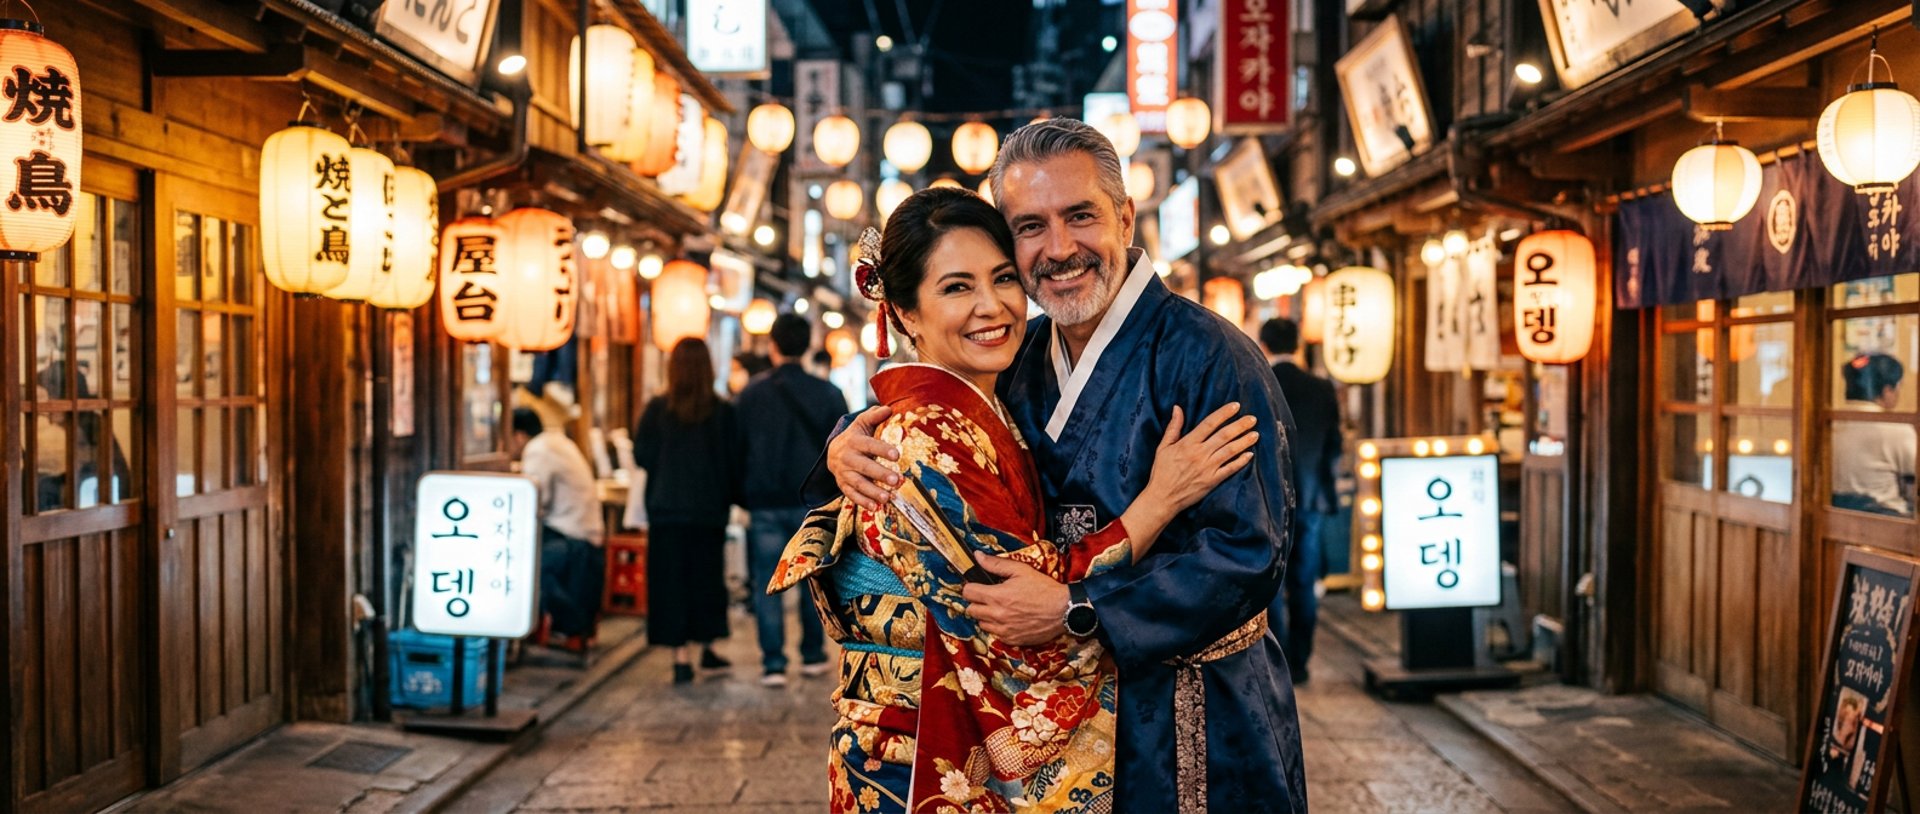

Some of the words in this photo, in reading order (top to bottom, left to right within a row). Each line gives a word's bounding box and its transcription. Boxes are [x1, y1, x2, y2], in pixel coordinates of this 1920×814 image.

[3, 65, 76, 217] 焼鳥
[315, 153, 352, 267] 焼と鳥
[451, 235, 498, 322] 屋台
[1523, 253, 1558, 345] 오뎅
[431, 498, 479, 618] 오뎅
[490, 492, 514, 597] 이자카야
[1417, 477, 1463, 589] 오뎅
